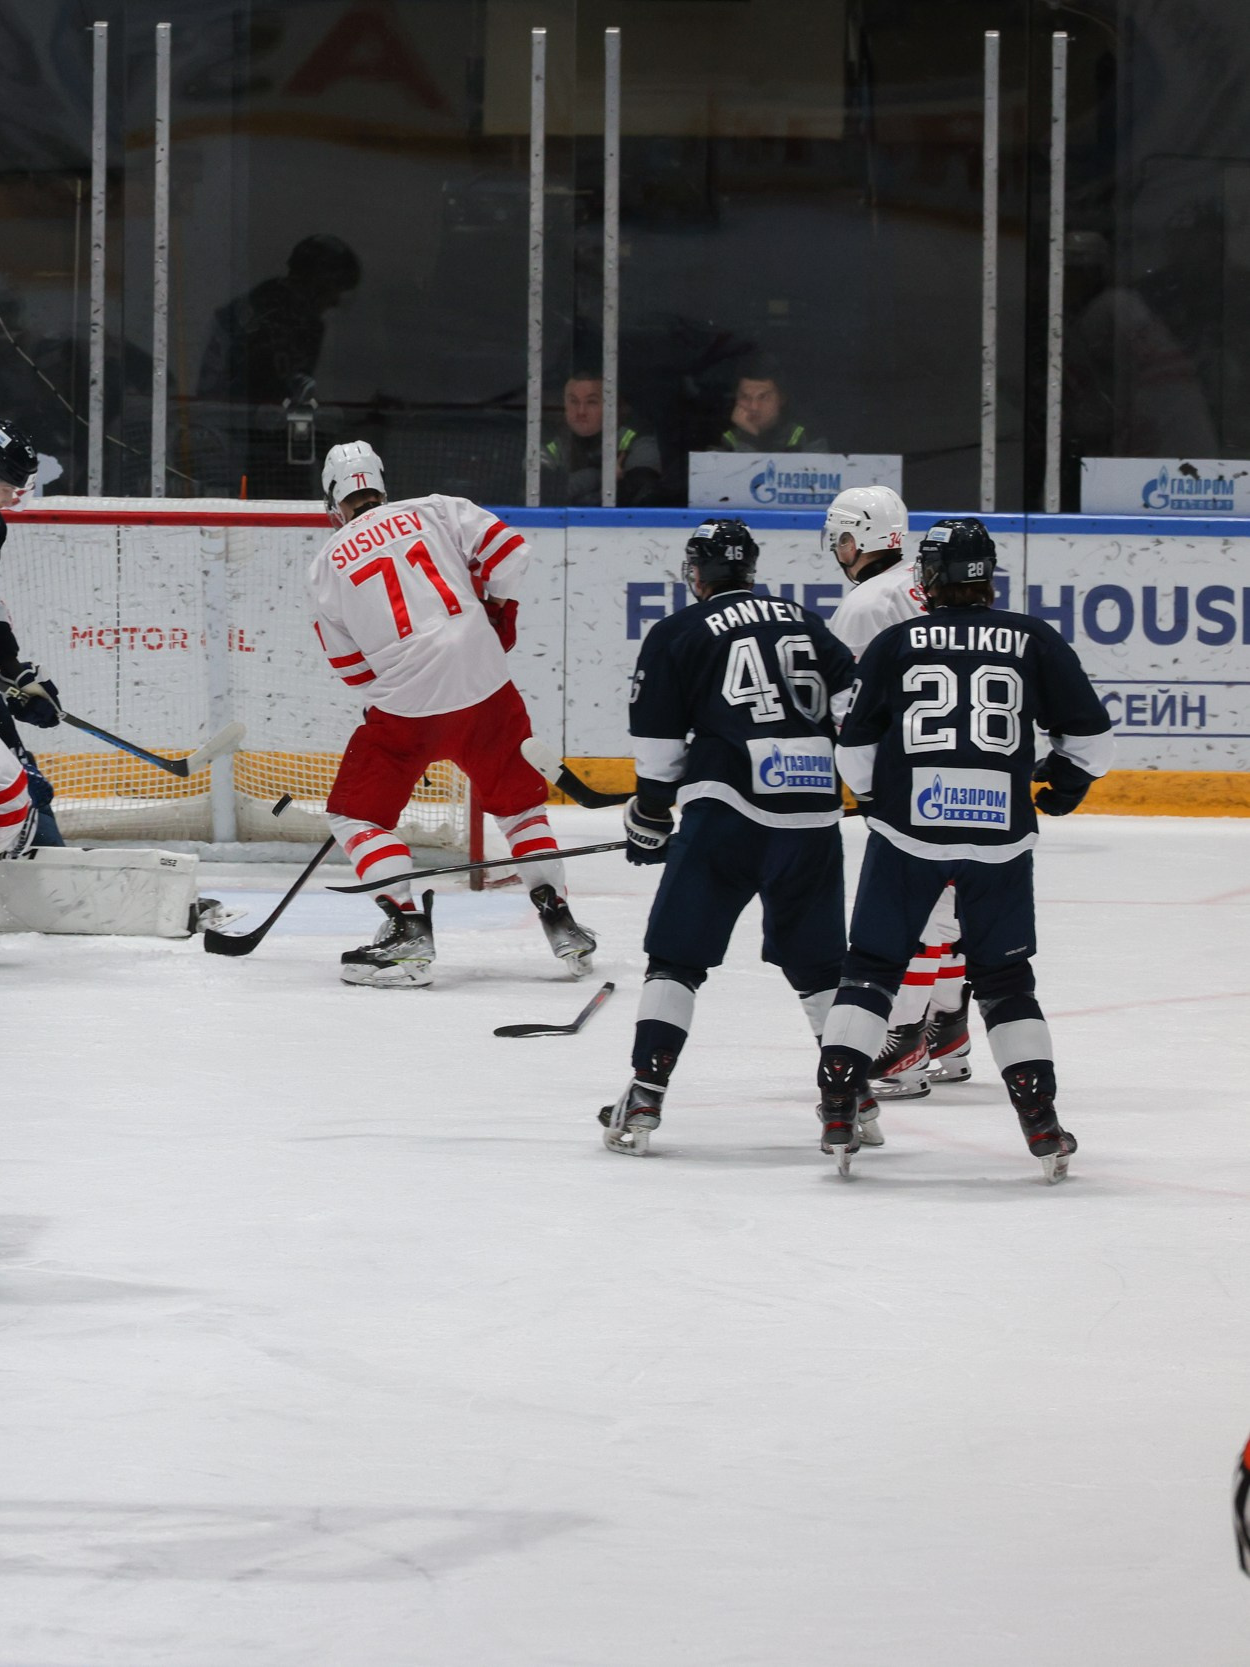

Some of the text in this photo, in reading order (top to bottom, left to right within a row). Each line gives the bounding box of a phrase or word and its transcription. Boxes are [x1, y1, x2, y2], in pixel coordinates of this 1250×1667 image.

[352, 473, 367, 489] 71
[778, 472, 841, 490] ГАЗПРОМ
[1171, 479, 1234, 495] ГАЗПРОМ
[331, 510, 424, 570] SUSUYEV
[887, 532, 902, 549] 34
[724, 545, 744, 561] 46
[967, 561, 985, 578] 28
[350, 540, 463, 640] 71
[704, 599, 805, 637] RANYEV
[70, 625, 255, 652] MOTOR IL
[909, 626, 1030, 659] GOLIKOV
[721, 634, 828, 725] 46
[902, 664, 1024, 757] 28
[784, 755, 832, 773] ГАЗПРОМ
[944, 787, 1007, 809] ГАЗПРОМ
[944, 809, 1005, 823] ЭКСПОРТ
